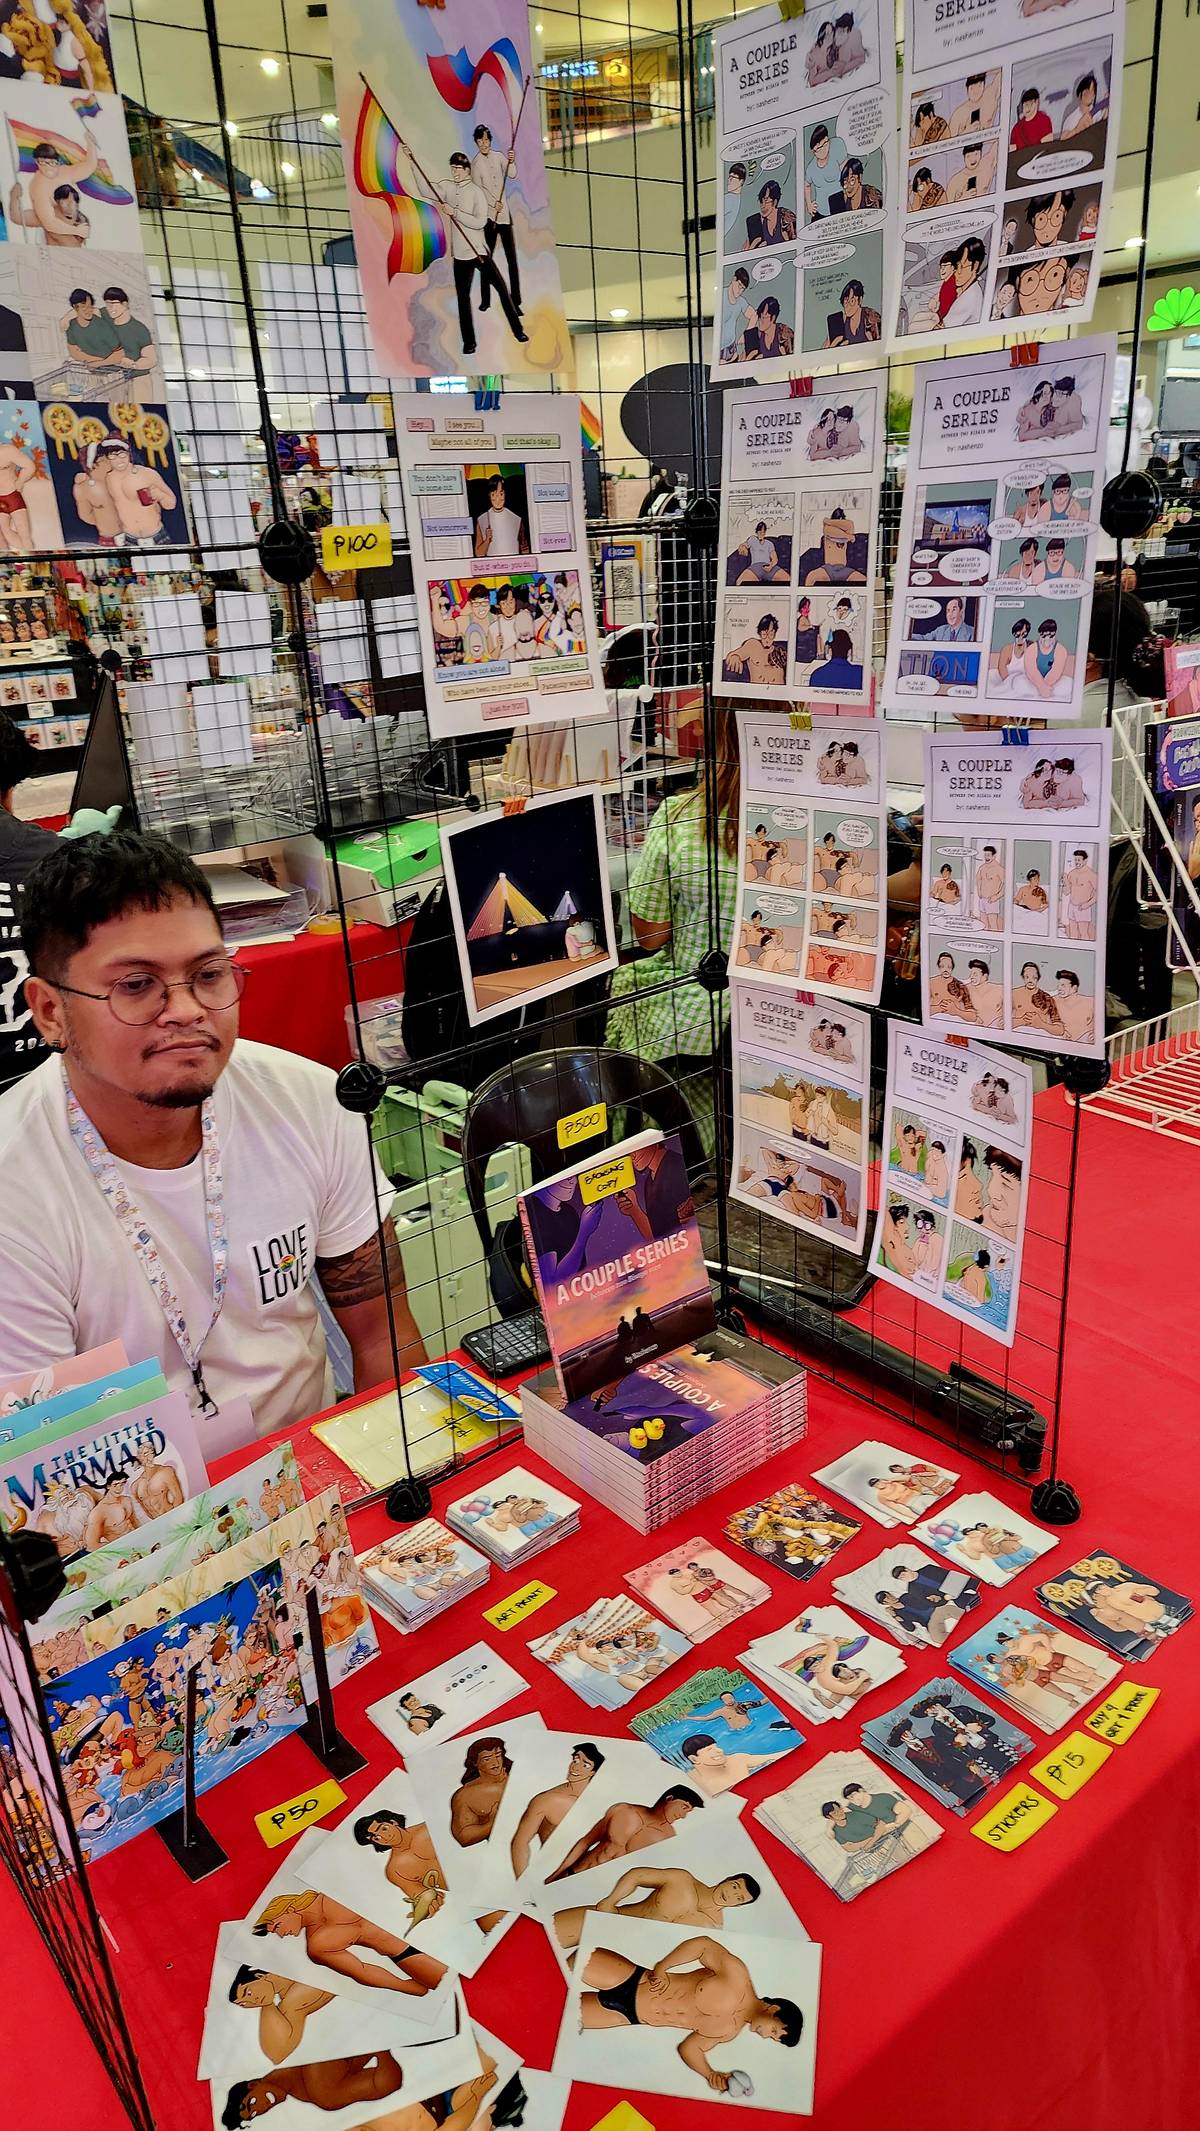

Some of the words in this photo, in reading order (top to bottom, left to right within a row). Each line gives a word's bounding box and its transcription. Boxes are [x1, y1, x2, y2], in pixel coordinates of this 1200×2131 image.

[935, 0, 996, 21] SERI
[730, 57, 739, 72] A
[746, 34, 798, 69] COUPLE
[739, 59, 789, 90] SERIES
[933, 396, 944, 410] A
[953, 387, 1011, 408] COUPLE
[739, 417, 748, 431] A
[754, 412, 802, 429] COUPLE
[942, 409, 1000, 429] SERIES
[746, 431, 793, 447] SERIES
[753, 736, 760, 747] A
[767, 737, 811, 751] COUPLE
[761, 752, 804, 766] SERIES
[940, 760, 949, 772] A
[958, 759, 1012, 772] COUPLE
[949, 777, 1002, 790] SERIES
[745, 997, 753, 1008] A
[760, 1001, 804, 1020] COUPLE
[753, 1012, 797, 1031] SERIES
[904, 1045, 912, 1057] A
[920, 1050, 968, 1073] COUPLE
[911, 1062, 958, 1086] SERIES
[585, 1162, 624, 1184] BROWSING
[597, 1177, 618, 1192] COPY
[252, 1223, 308, 1276] LOVE
[556, 1284, 569, 1305] A
[571, 1254, 635, 1297] COUPLE
[636, 1229, 690, 1268] SERIES
[260, 1253, 308, 1305] LOVE
[649, 1367, 712, 1407] COUPLE
[706, 1398, 726, 1413] A
[51, 1444, 88, 1470] THE
[92, 1417, 156, 1453] LITTLE
[495, 1608, 517, 1625] ART
[515, 1587, 544, 1609] PRINT
[1090, 1710, 1109, 1729] BUY
[1105, 1723, 1124, 1738] GET
[1117, 1710, 1131, 1720] 1
[1124, 1691, 1148, 1713] FREE
[988, 1795, 1040, 1842] STICKERS
